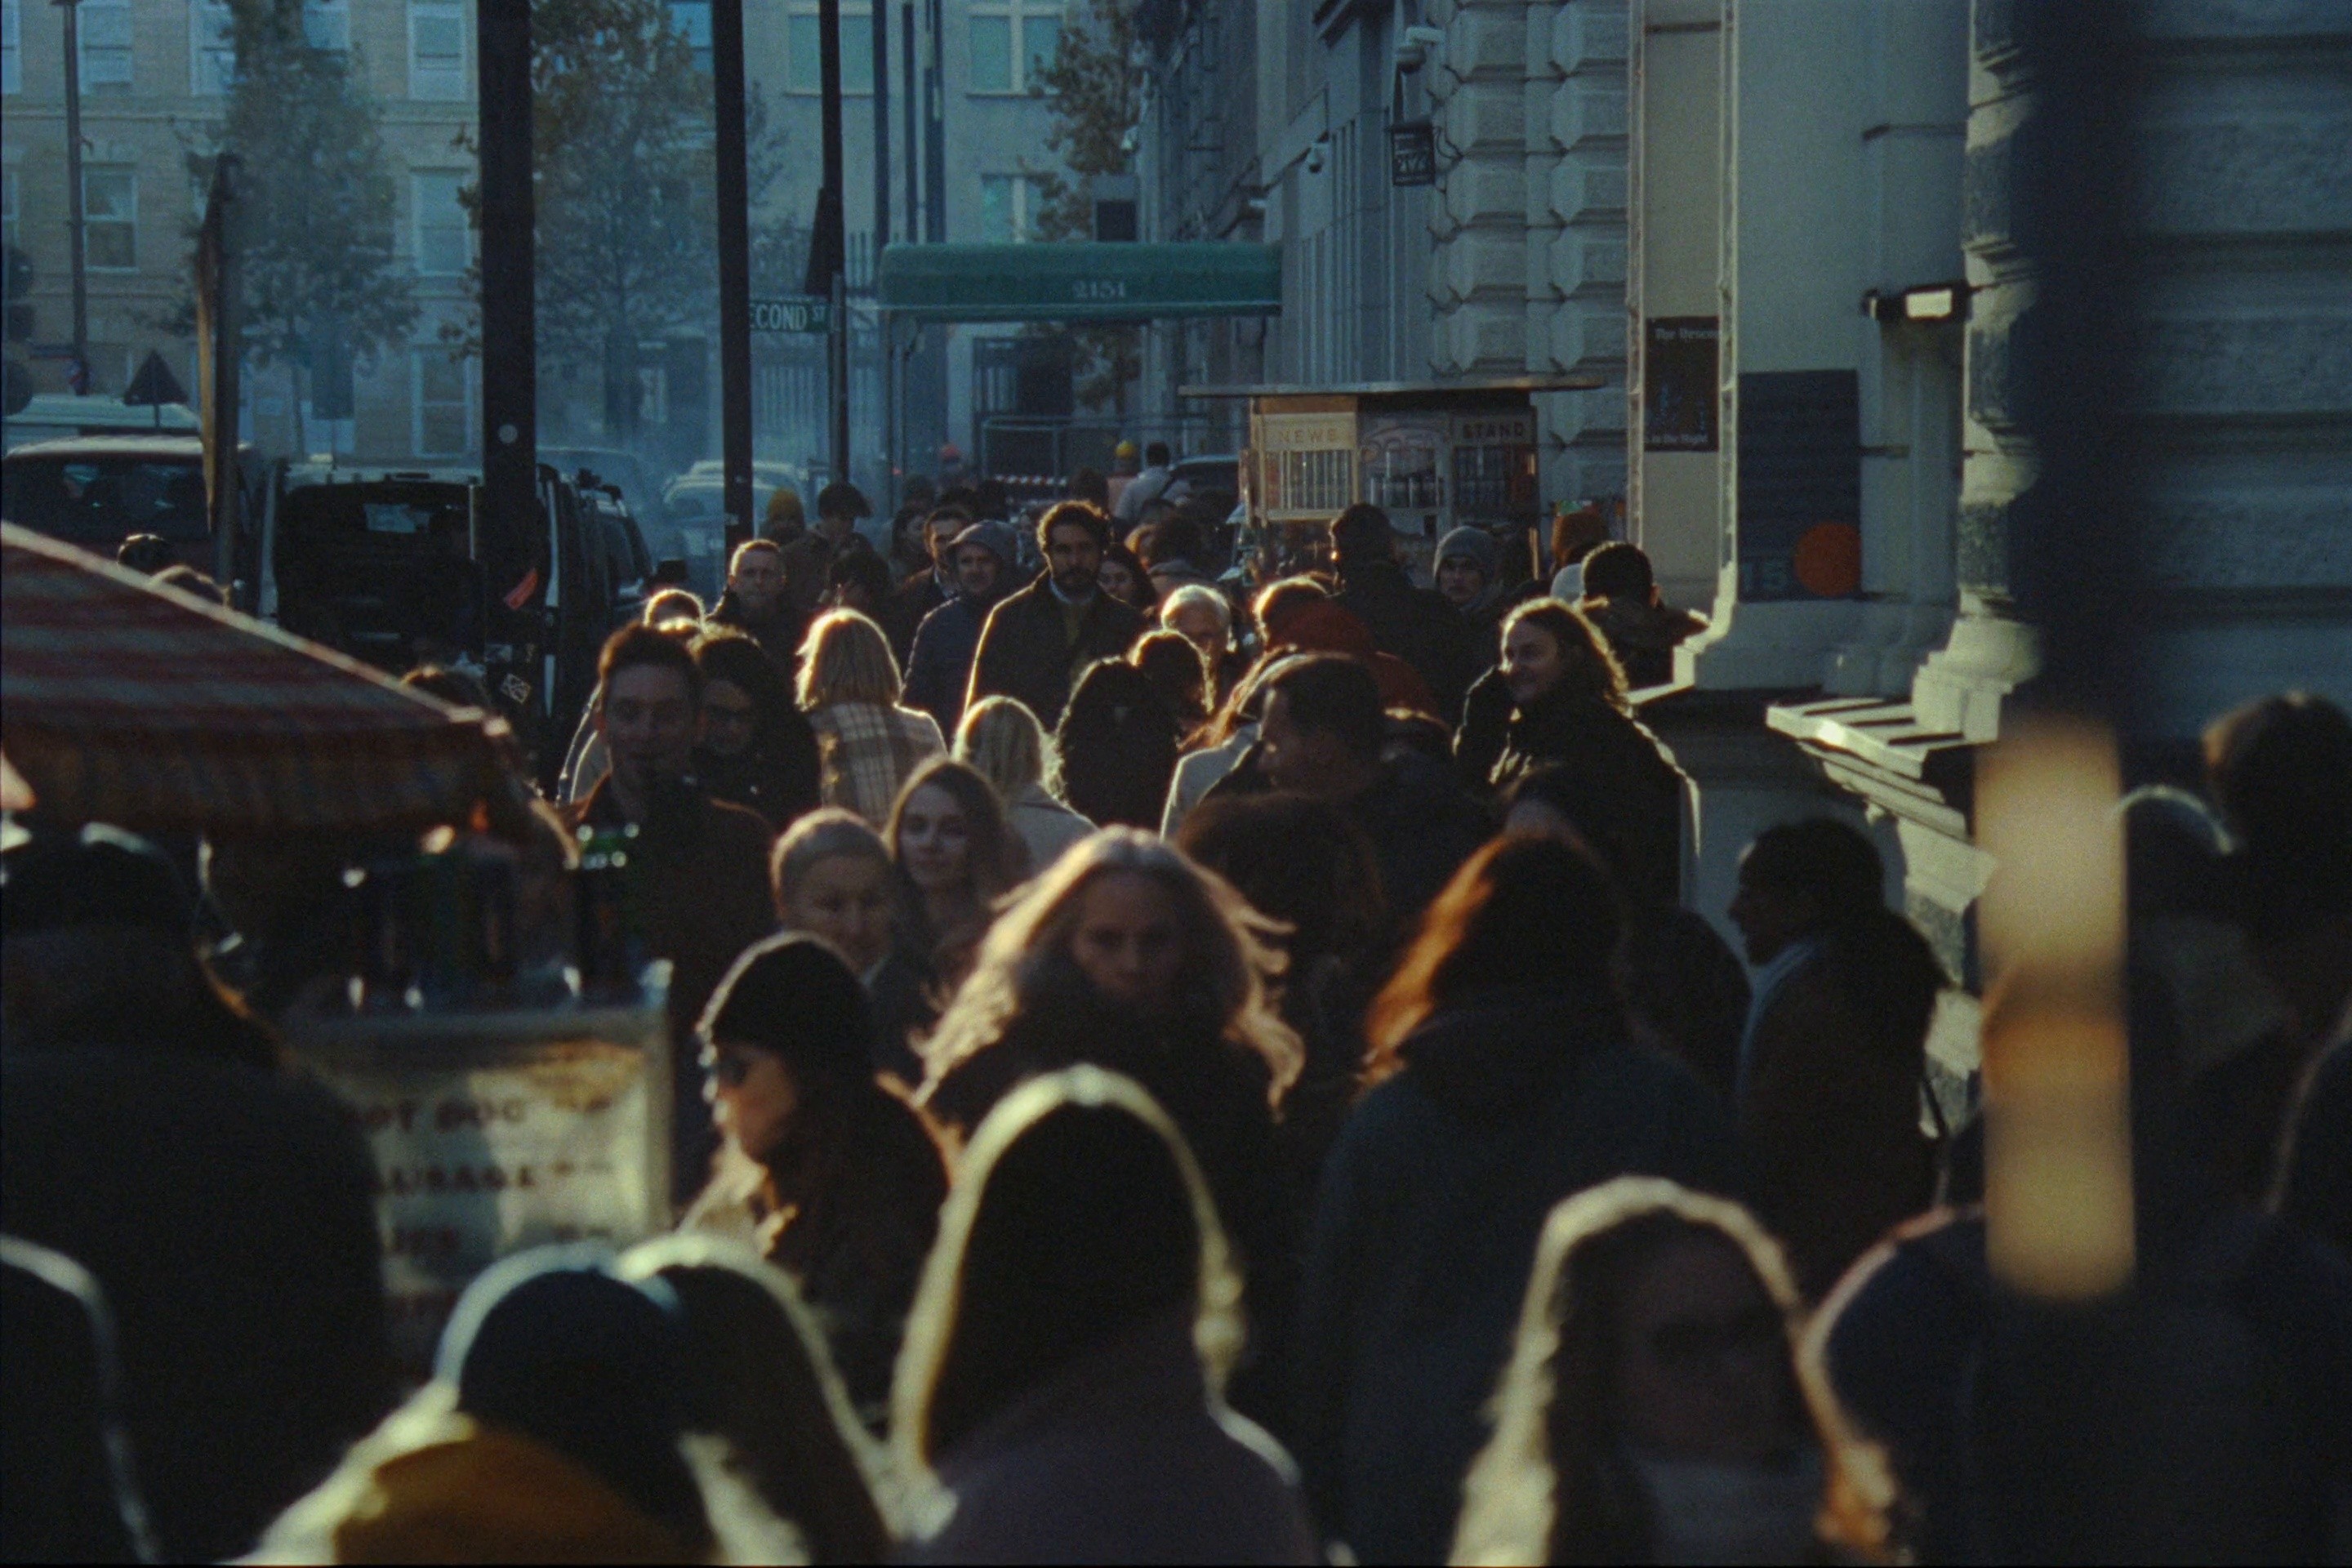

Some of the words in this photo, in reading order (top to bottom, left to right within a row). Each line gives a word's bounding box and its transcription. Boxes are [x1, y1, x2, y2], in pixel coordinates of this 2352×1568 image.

[750, 304, 807, 330] ECOND
[1279, 427, 1337, 443] NEWS
[1463, 421, 1525, 439] STAND
